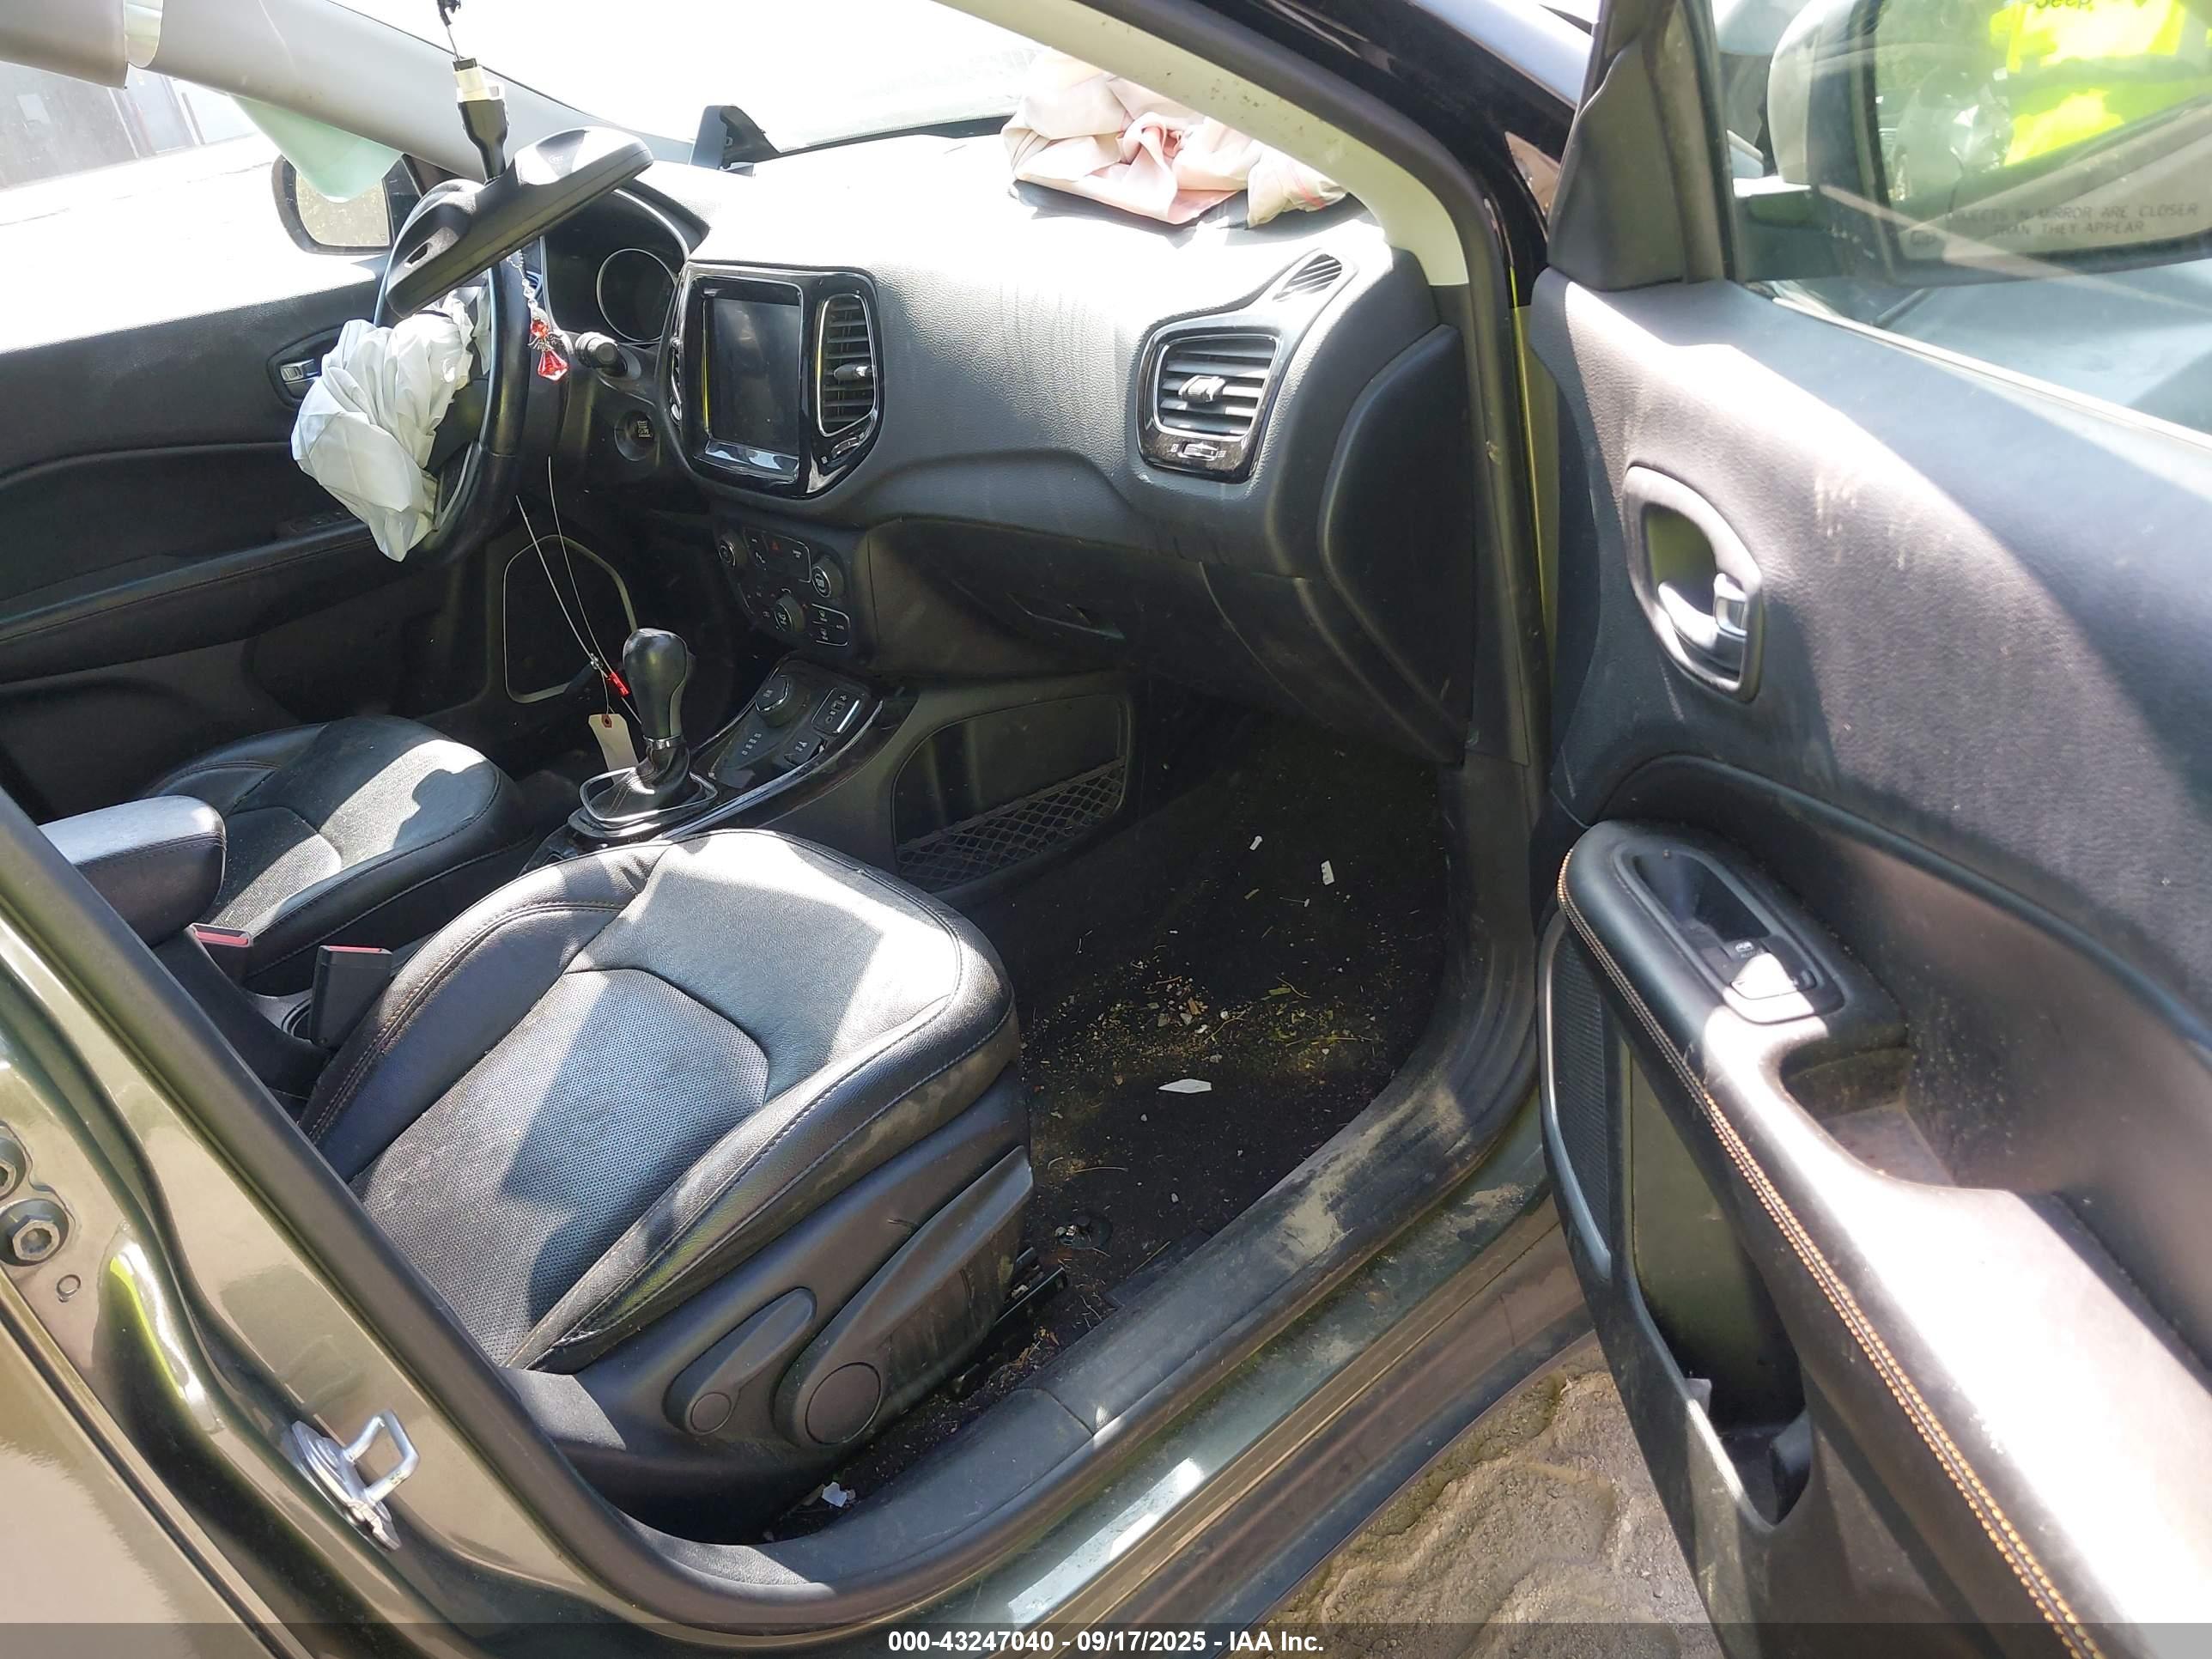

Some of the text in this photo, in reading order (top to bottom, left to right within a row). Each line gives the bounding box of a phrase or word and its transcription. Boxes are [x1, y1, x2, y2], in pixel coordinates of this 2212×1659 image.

[2101, 205, 2129, 218] ARE
[2138, 203, 2198, 217] CLOSER
[2042, 222, 2076, 234] THEY
[2086, 220, 2145, 234] APPEAR
